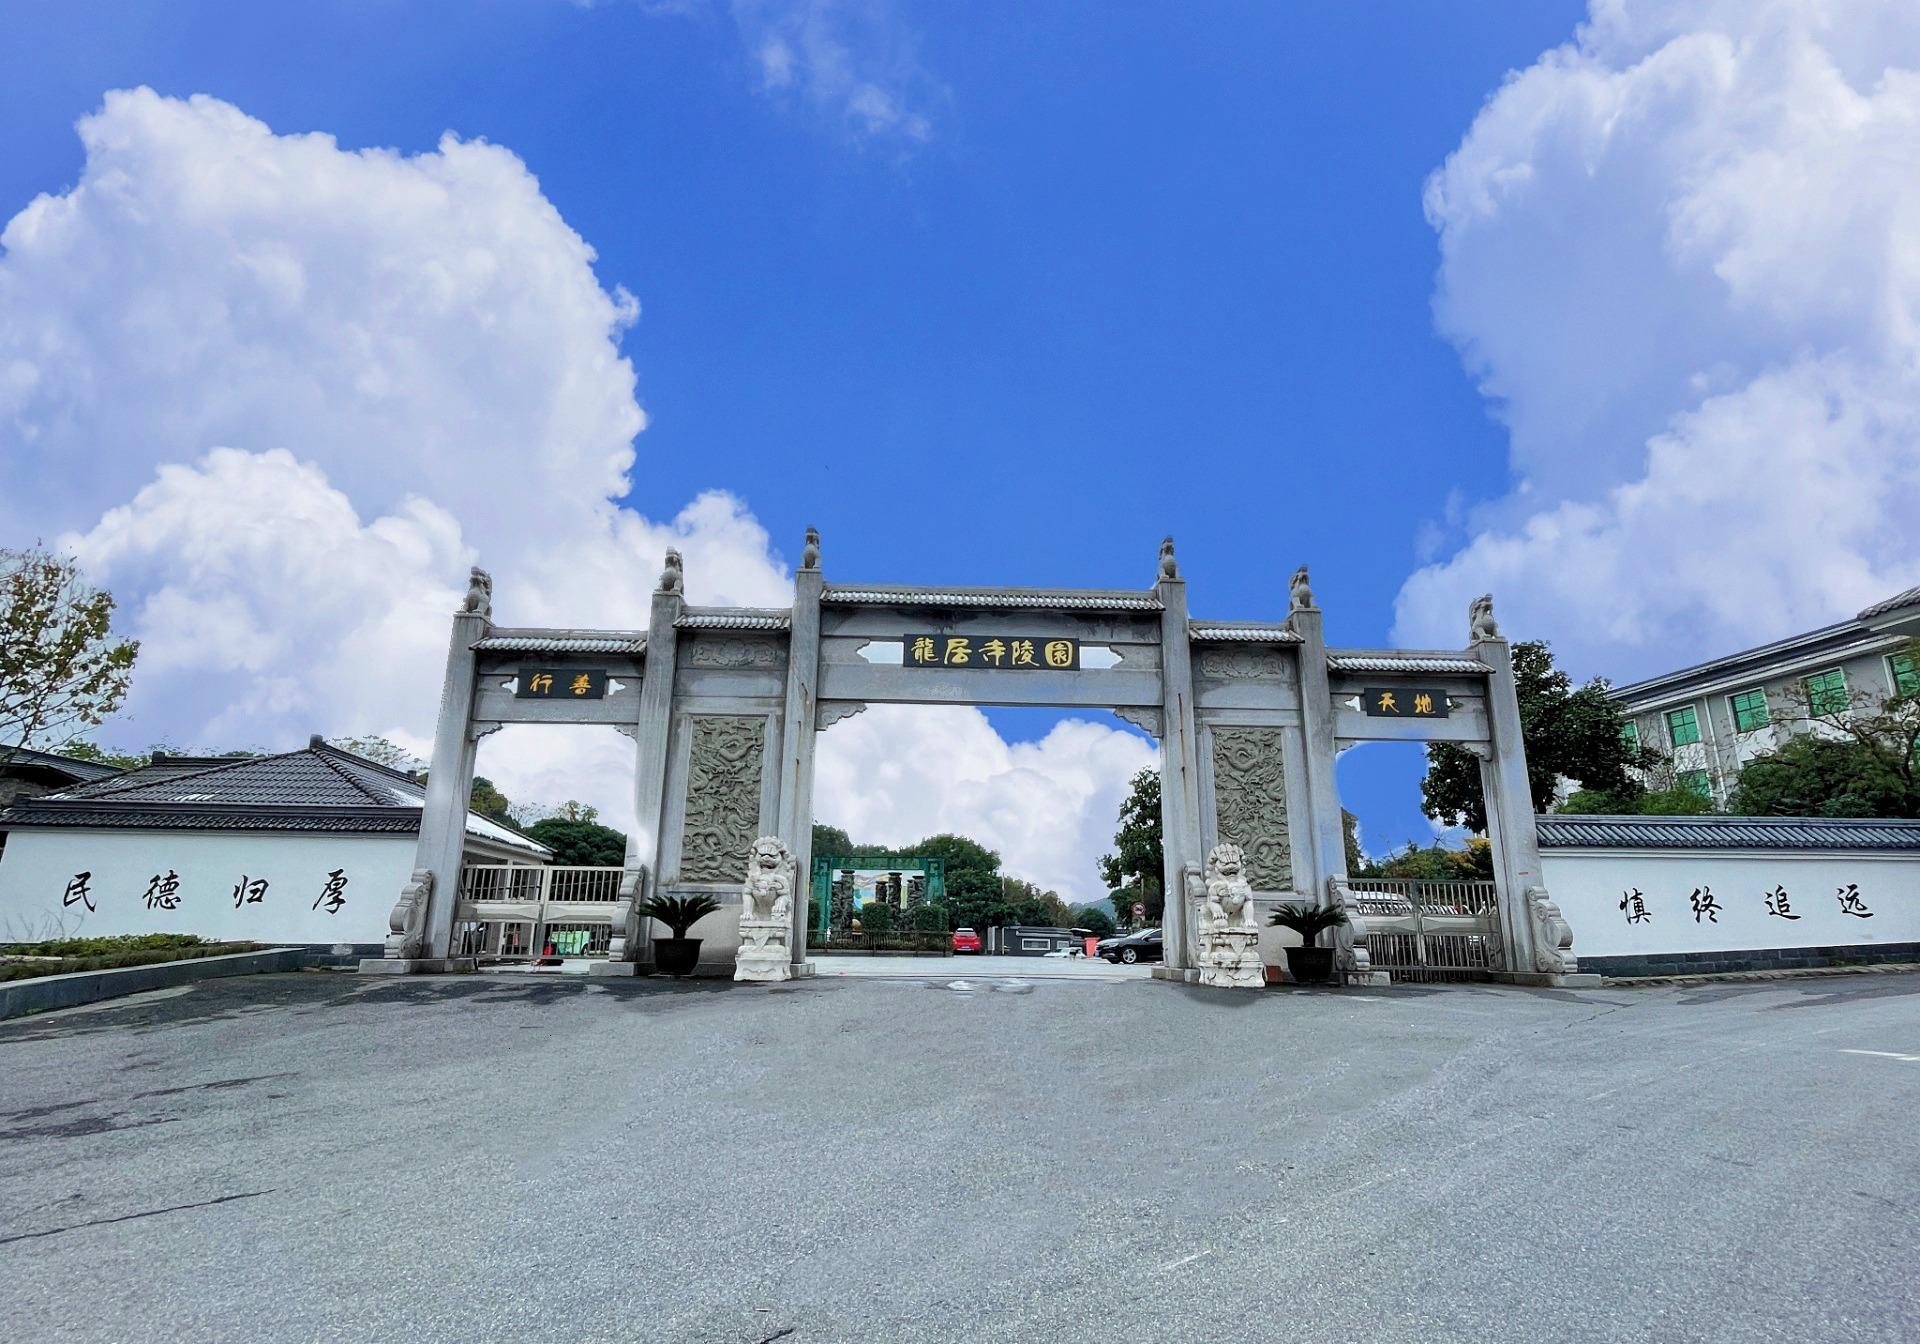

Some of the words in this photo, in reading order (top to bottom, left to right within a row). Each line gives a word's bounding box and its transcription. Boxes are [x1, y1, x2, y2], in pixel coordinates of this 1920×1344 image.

[911, 637, 1073, 667] 龍居寺陵園
[530, 673, 591, 695] 行善
[1378, 692, 1436, 714] 天地
[63, 868, 348, 915] 民德归厚
[1619, 883, 1874, 925] 慎终追远
